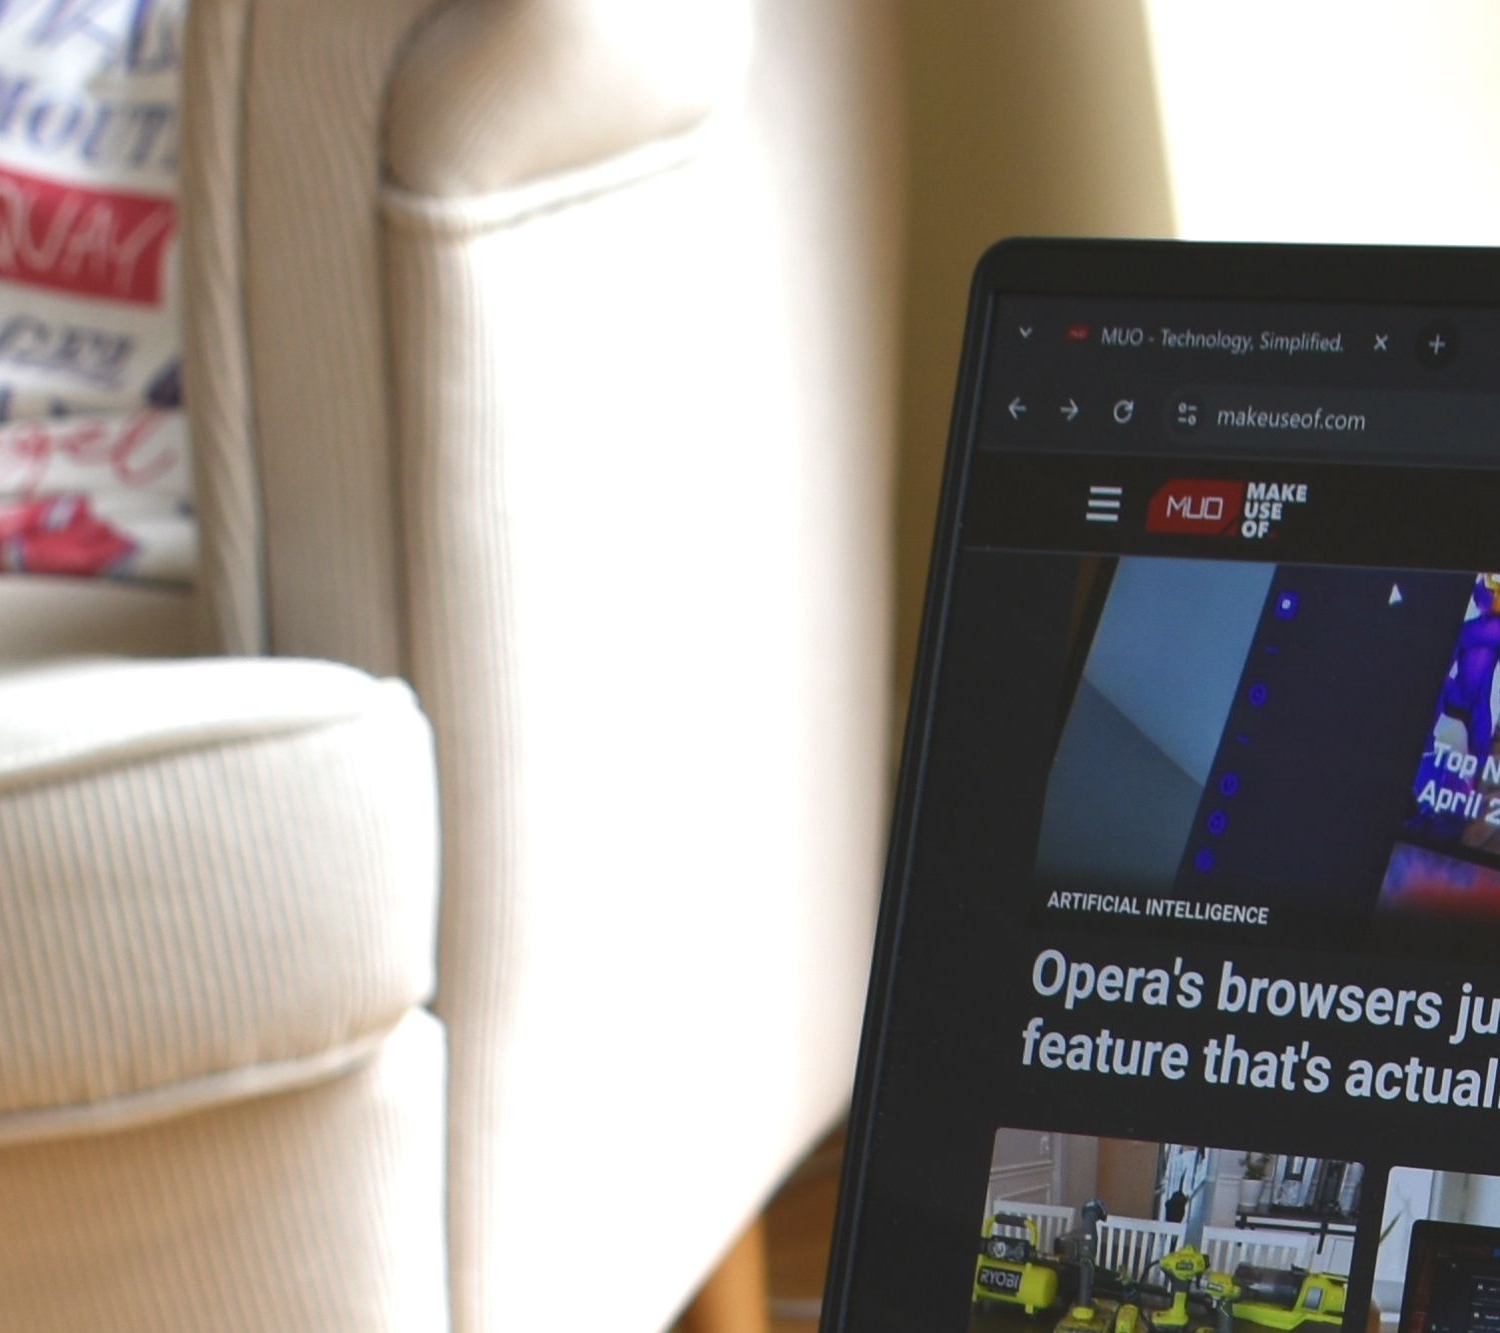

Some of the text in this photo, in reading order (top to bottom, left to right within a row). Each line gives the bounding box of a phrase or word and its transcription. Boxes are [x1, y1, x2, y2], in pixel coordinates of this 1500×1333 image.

[1101, 327, 1144, 346] MUO
[1161, 328, 1254, 355] Technology,
[1259, 331, 1343, 355] Simplified.
[1217, 405, 1366, 431] makeuseof.com
[1246, 482, 1308, 503] MAKE
[1166, 495, 1224, 520] MUO
[1244, 501, 1283, 520] USE
[1241, 519, 1270, 539] OF
[1433, 741, 1479, 779] Top
[1416, 779, 1484, 819] April
[1047, 890, 1270, 925] ARTIFICIAL INTELLIGENCE
[1032, 949, 1204, 1010] Opera's
[1216, 960, 1443, 1030] browsers
[1022, 1016, 1189, 1080] feature
[1203, 1033, 1332, 1094] that's
[980, 1268, 1020, 1289] RYOBI
